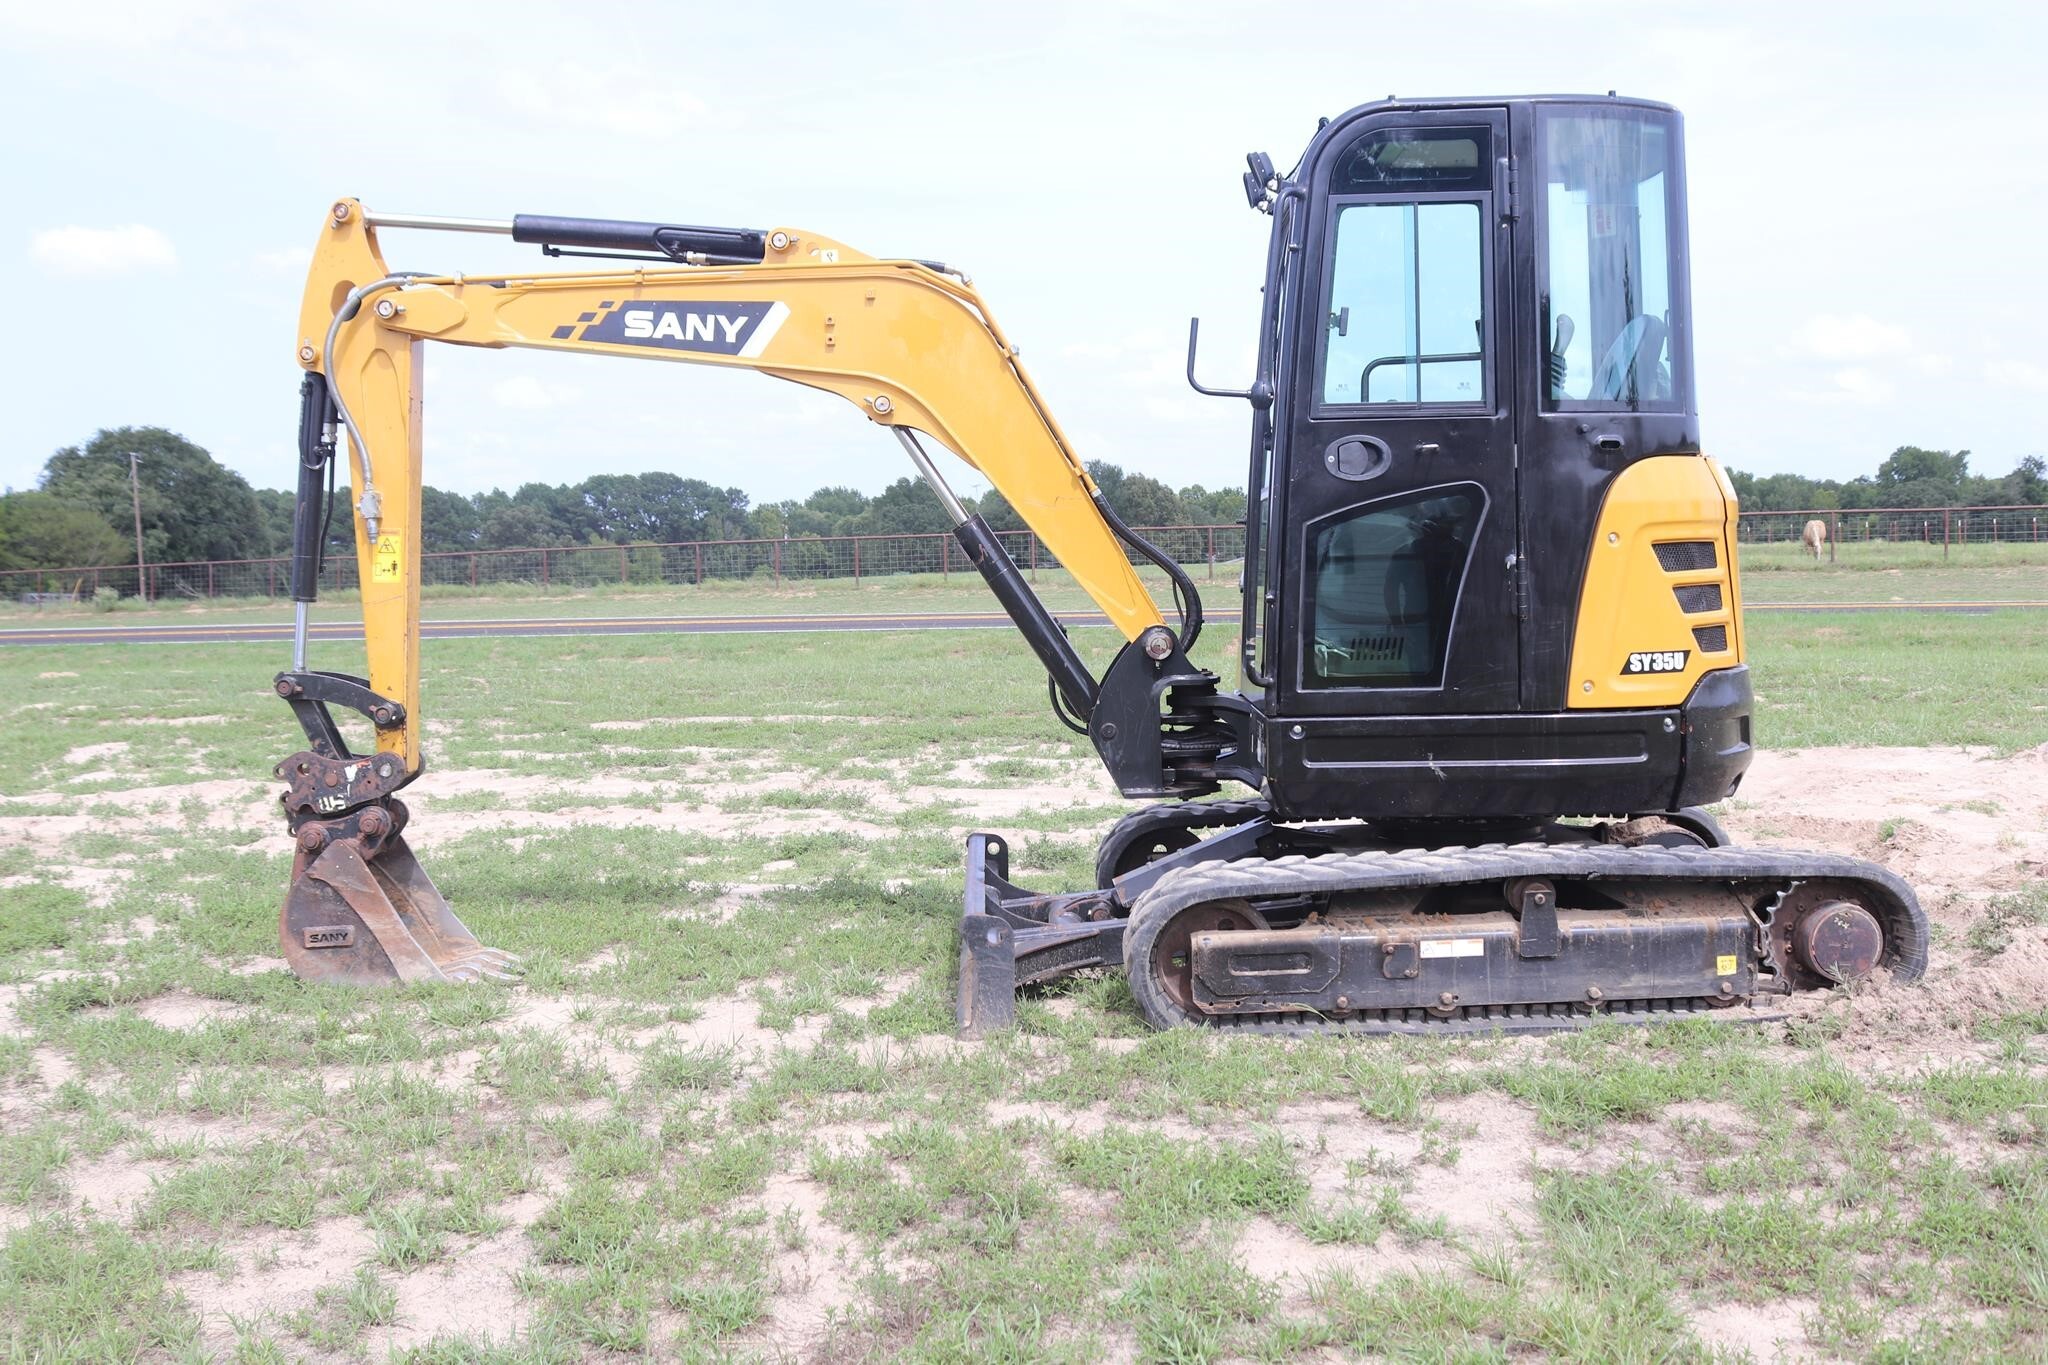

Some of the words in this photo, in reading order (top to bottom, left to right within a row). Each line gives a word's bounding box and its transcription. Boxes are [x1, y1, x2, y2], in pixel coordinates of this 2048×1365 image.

[624, 310, 749, 343] SANY
[1629, 652, 1685, 672] SY35U
[310, 932, 348, 943] SANY
